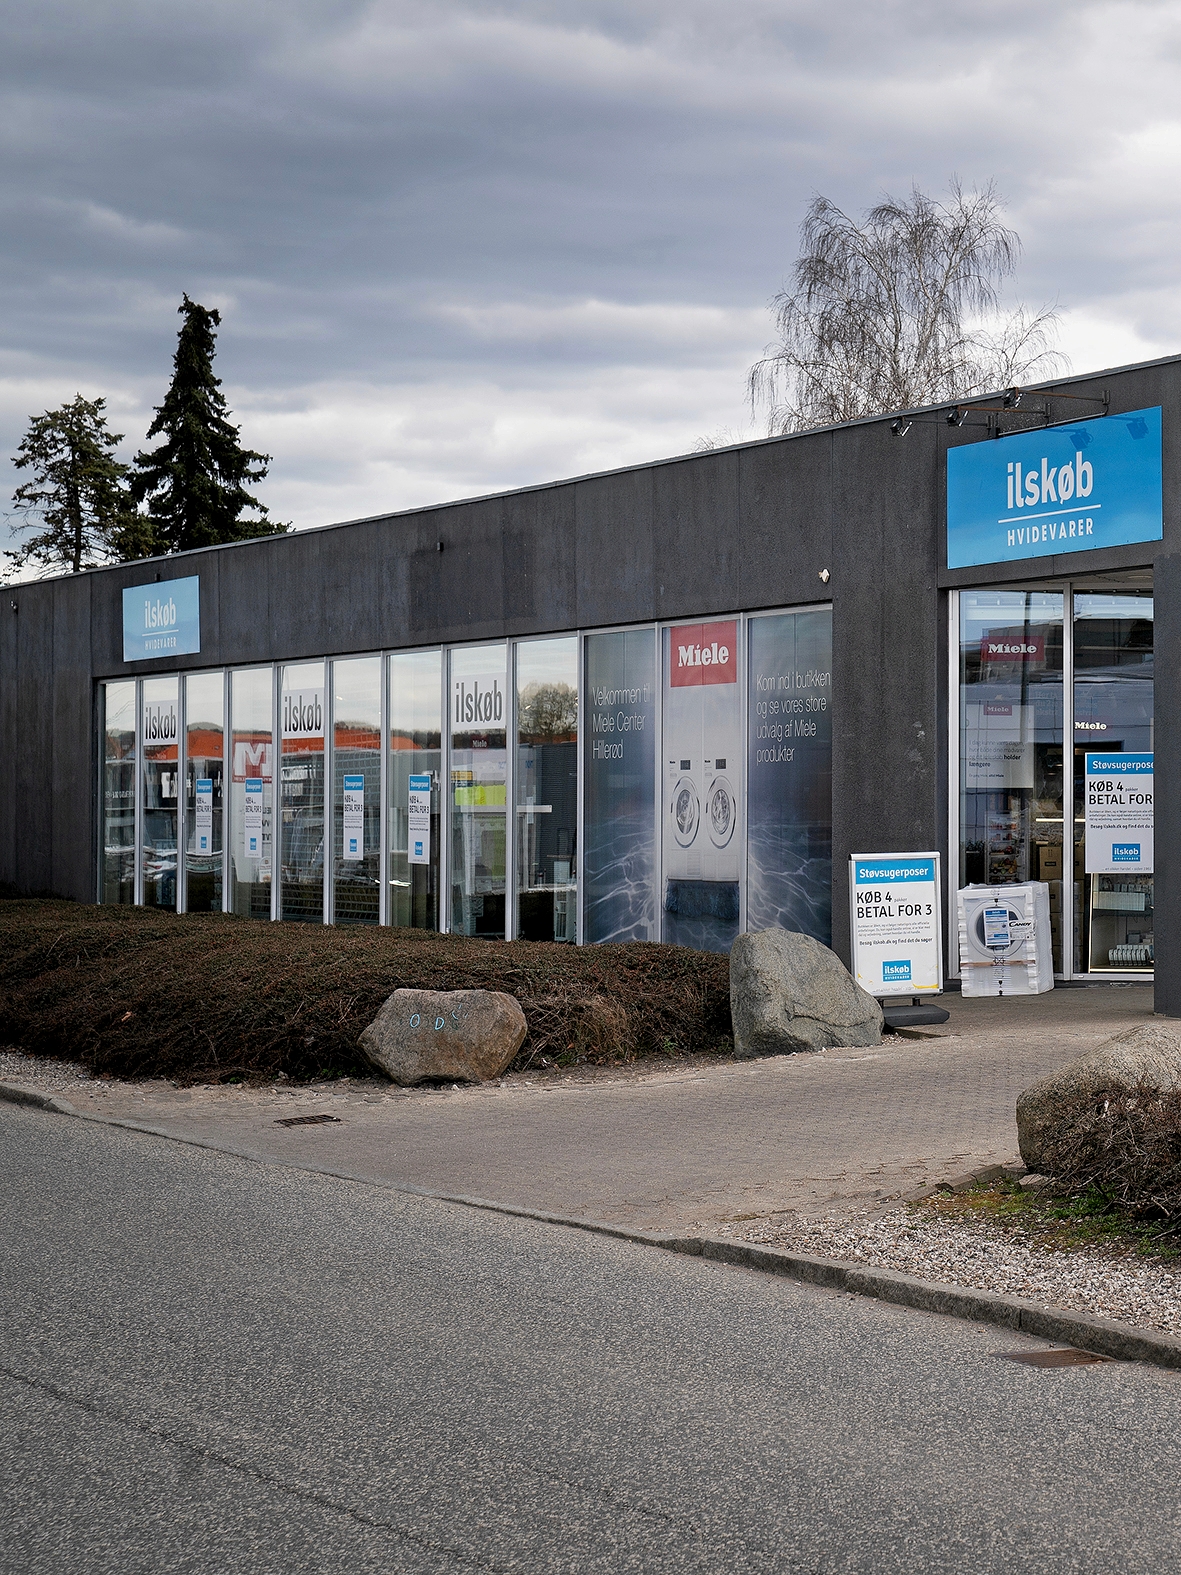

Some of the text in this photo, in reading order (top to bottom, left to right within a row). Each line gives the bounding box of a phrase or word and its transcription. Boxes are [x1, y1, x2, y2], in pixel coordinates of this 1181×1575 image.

[1006, 449, 1094, 510] ilskøb
[1006, 521, 1094, 548] HVIDEVARER
[145, 597, 176, 628] ilskøb
[144, 637, 177, 650] HVIDEVARER
[988, 643, 1037, 654] Miele
[678, 642, 729, 667] Miele
[756, 673, 775, 691] Kom
[455, 680, 502, 723] ilskøb
[592, 686, 641, 706] Velkommen
[284, 694, 322, 732] ilskøb
[756, 697, 827, 717] og se vores store
[145, 705, 176, 740] ilskøb
[592, 711, 646, 732] Miele Center
[1074, 721, 1107, 730] Miele
[756, 721, 817, 742] udvalg af Miele
[592, 739, 624, 760] Hillerød
[756, 747, 795, 766] produkter
[1092, 760, 1153, 771] Støvsugerpose
[1088, 780, 1114, 793] KØB
[1116, 781, 1123, 792] 4
[1089, 793, 1153, 805] BETAL FOR
[1114, 848, 1139, 856] ilskøb
[859, 867, 929, 880] Støvsugerposer
[856, 890, 882, 904] KØB
[885, 891, 892, 903] 4
[857, 904, 932, 919] BETAL FOR 3
[884, 964, 910, 974] ilskøb
